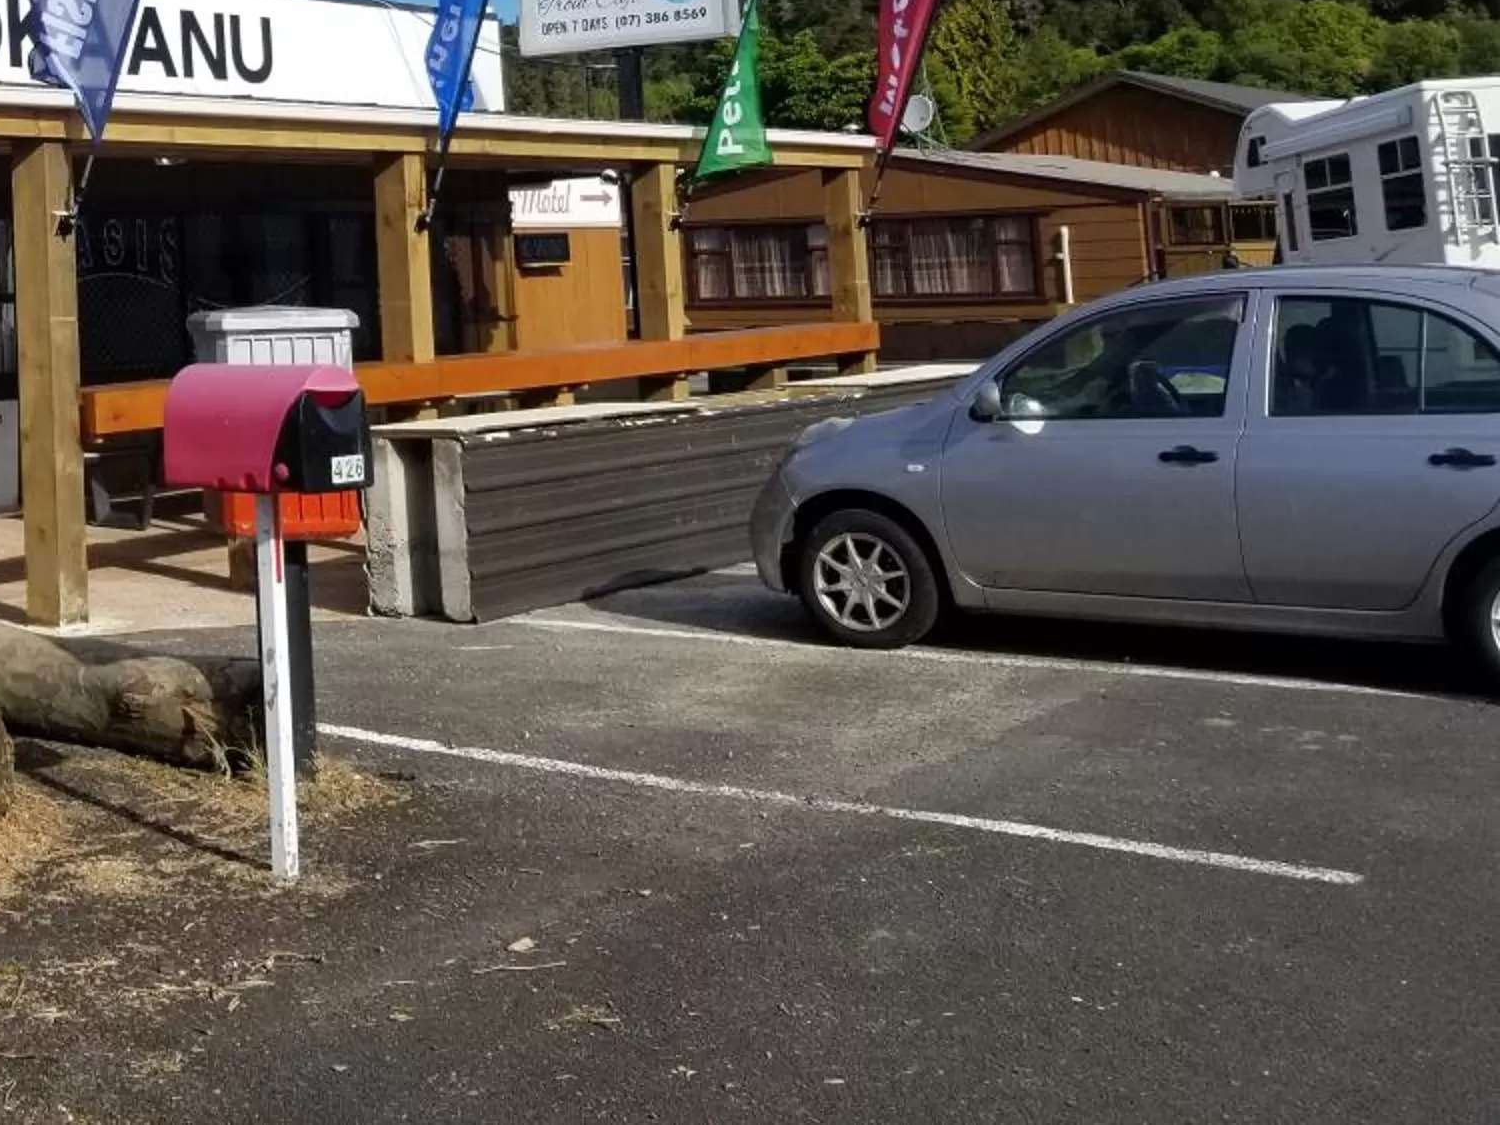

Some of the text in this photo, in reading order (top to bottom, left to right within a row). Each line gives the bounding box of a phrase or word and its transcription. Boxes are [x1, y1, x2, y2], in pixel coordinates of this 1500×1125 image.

[541, 20, 567, 36] OPEN
[582, 17, 608, 32] DAYS
[615, 14, 641, 30] (07)
[645, 10, 669, 24] 386
[674, 7, 708, 21] 8569
[333, 457, 363, 480] 426
